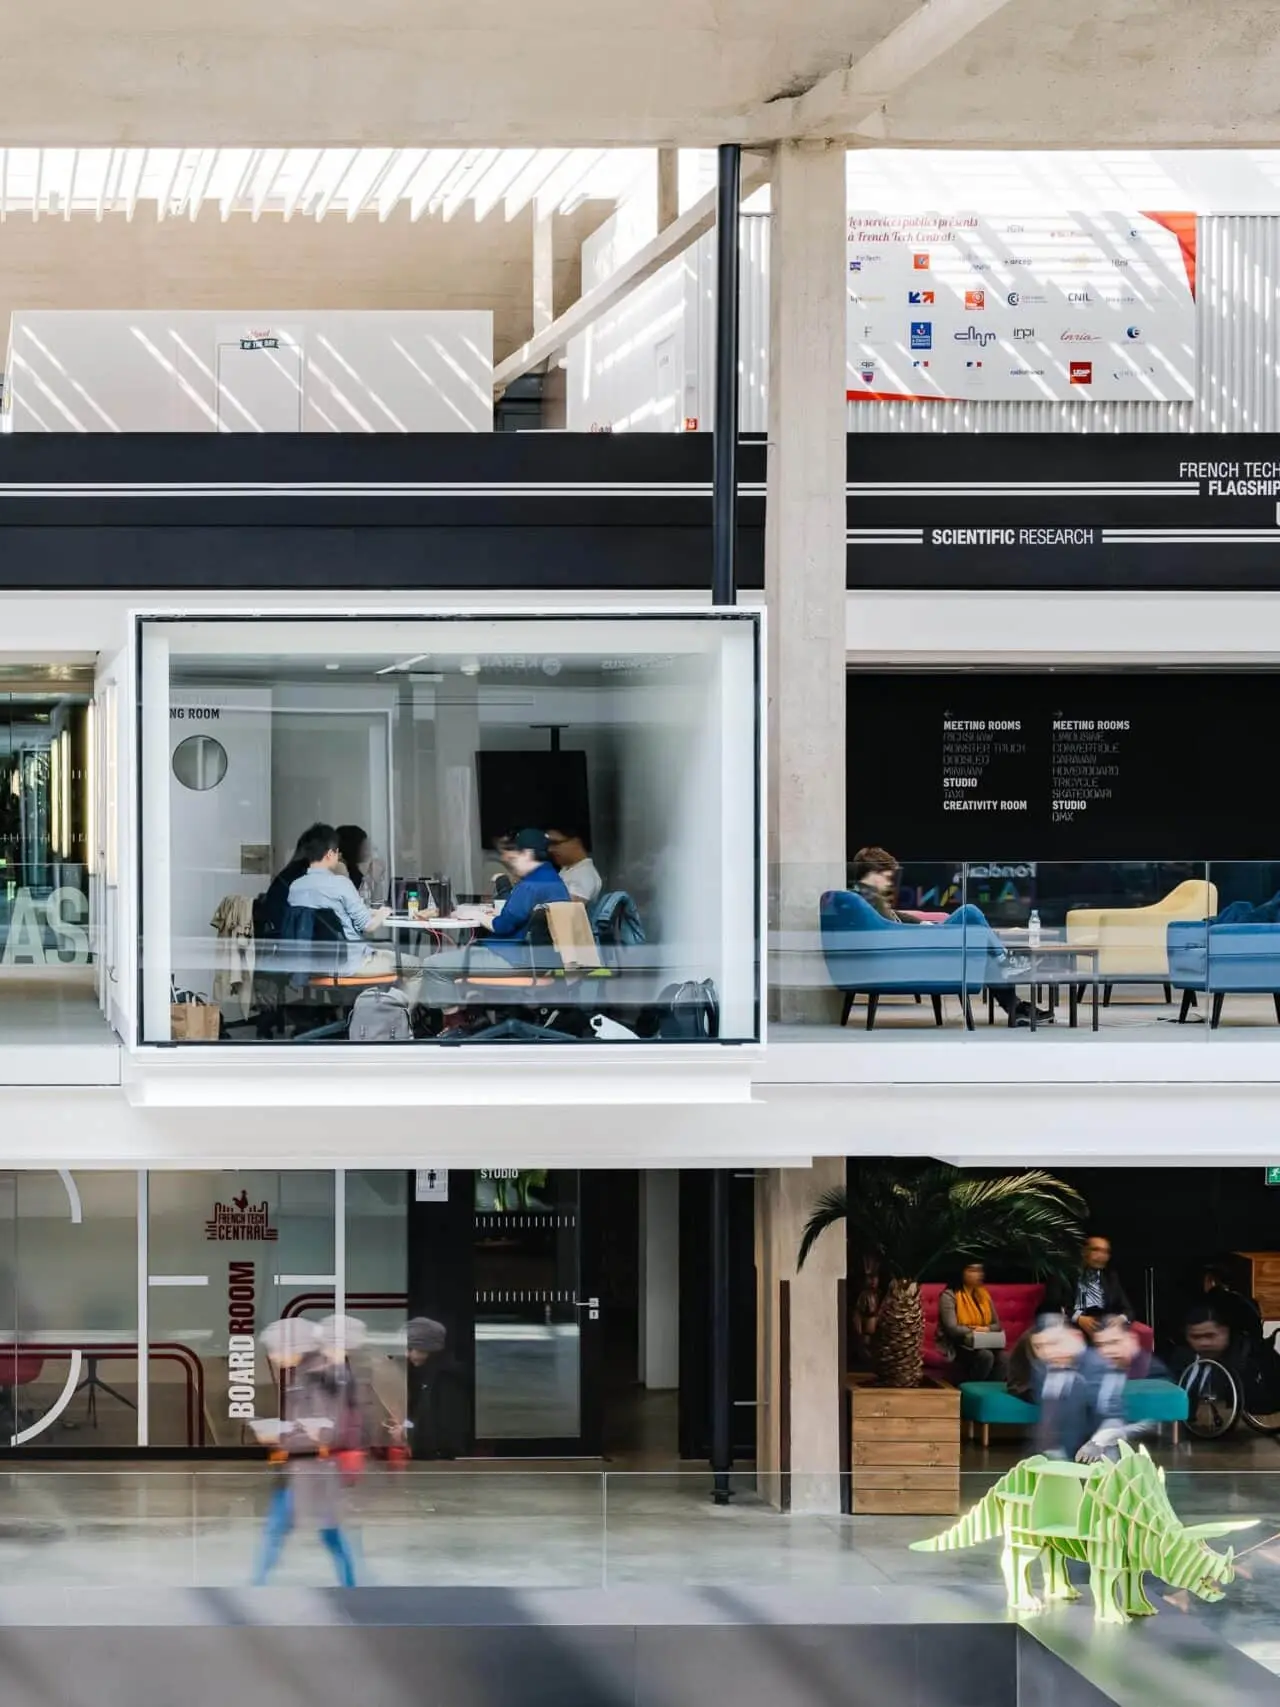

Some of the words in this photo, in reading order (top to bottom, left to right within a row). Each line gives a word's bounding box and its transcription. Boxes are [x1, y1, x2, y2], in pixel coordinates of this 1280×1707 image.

[1179, 462, 1239, 478] FRENCH
[1243, 462, 1280, 478] TECH
[1208, 480, 1280, 496] FLAGSHIP
[931, 529, 1015, 545] SCIENTIFIC
[1019, 529, 1094, 545] RESEARCH
[188, 708, 220, 719] ROOM
[943, 720, 986, 731] MEETING
[988, 720, 1021, 731] ROOMS
[1052, 720, 1095, 730] MEETING
[1097, 720, 1131, 730] ROOMS
[943, 778, 978, 787] STUDIO
[943, 800, 998, 810] CREATIVITY
[1000, 800, 1028, 810] ROOM
[1052, 800, 1087, 810] STUDIO
[480, 1168, 519, 1179] STUDIO
[218, 1213, 246, 1224] FRENCH
[247, 1213, 265, 1224] TECH
[218, 1225, 267, 1241] CENTRAL
